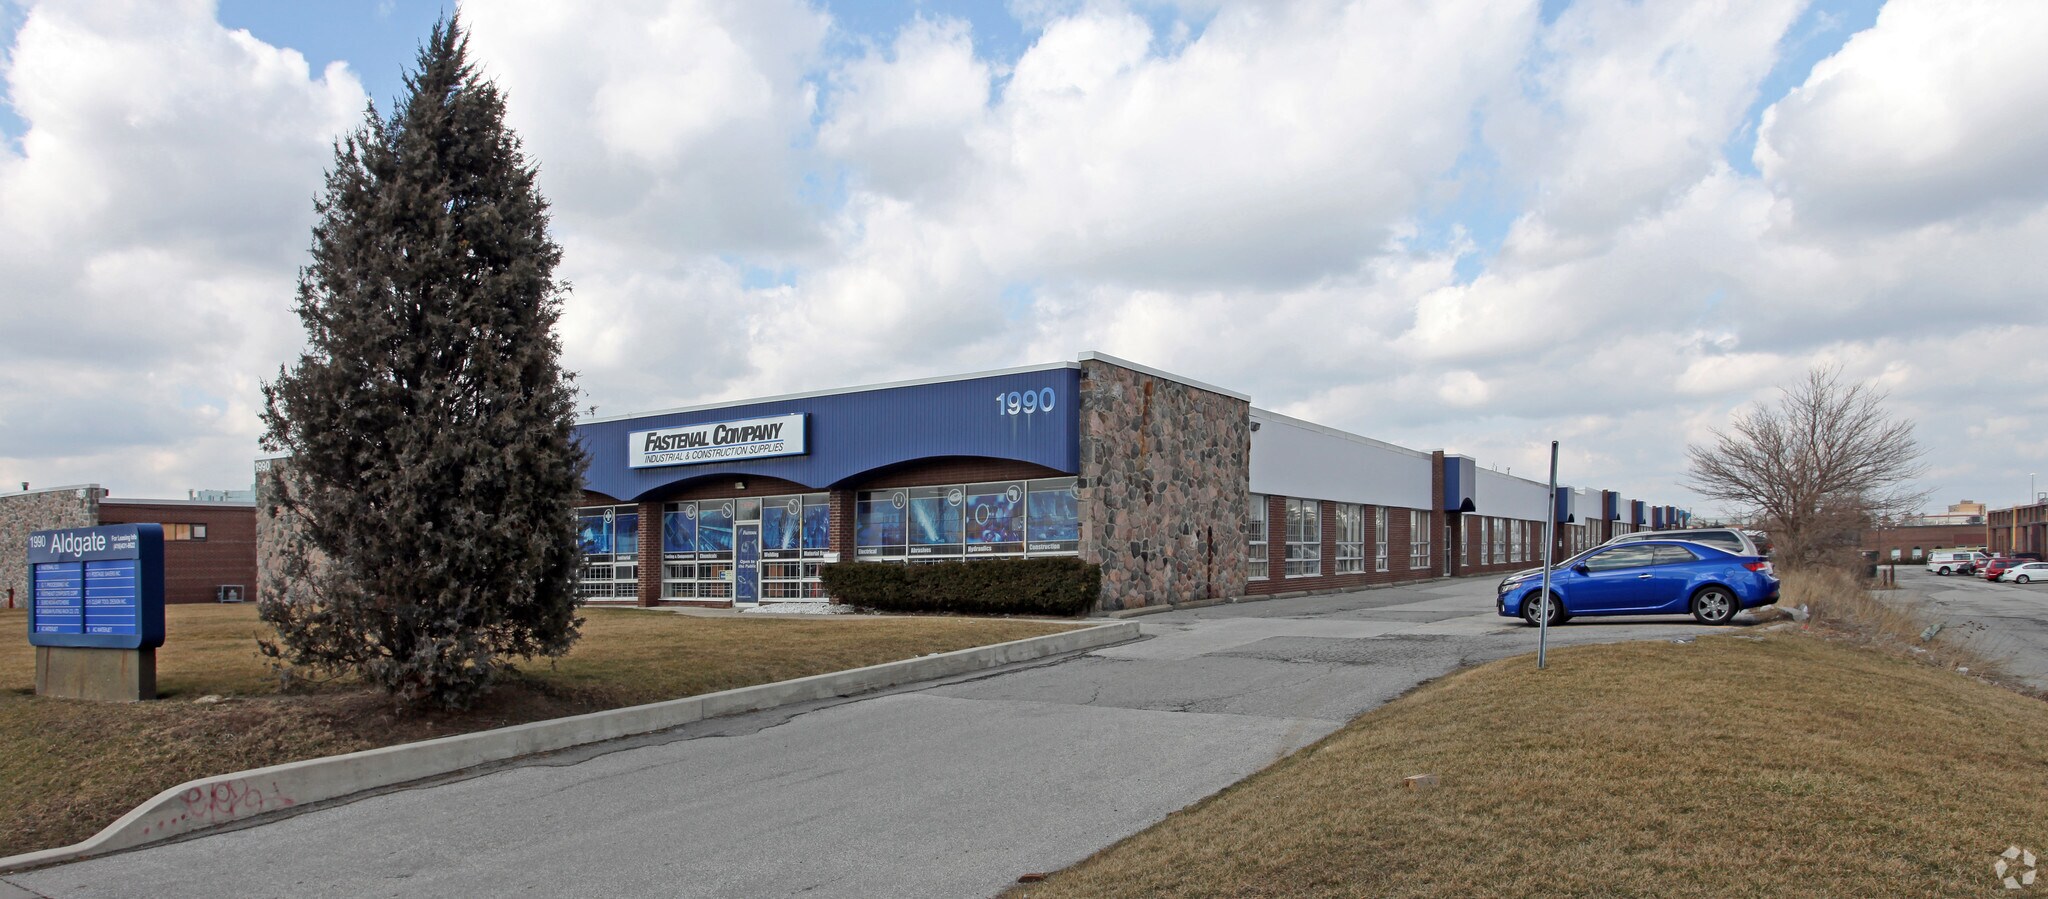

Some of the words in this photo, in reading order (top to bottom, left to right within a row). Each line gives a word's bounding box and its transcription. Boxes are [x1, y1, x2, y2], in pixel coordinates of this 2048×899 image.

[995, 387, 1056, 415] 1990
[644, 431, 709, 452] FASTENAL
[712, 422, 784, 445] COMPANY
[644, 451, 684, 464] INDUSTRIAL
[685, 451, 690, 460] &
[691, 447, 747, 460] CONSTRUCTION
[748, 442, 784, 454] SUPPLIES
[30, 535, 46, 548] 1990
[50, 531, 106, 557] Aldgate
